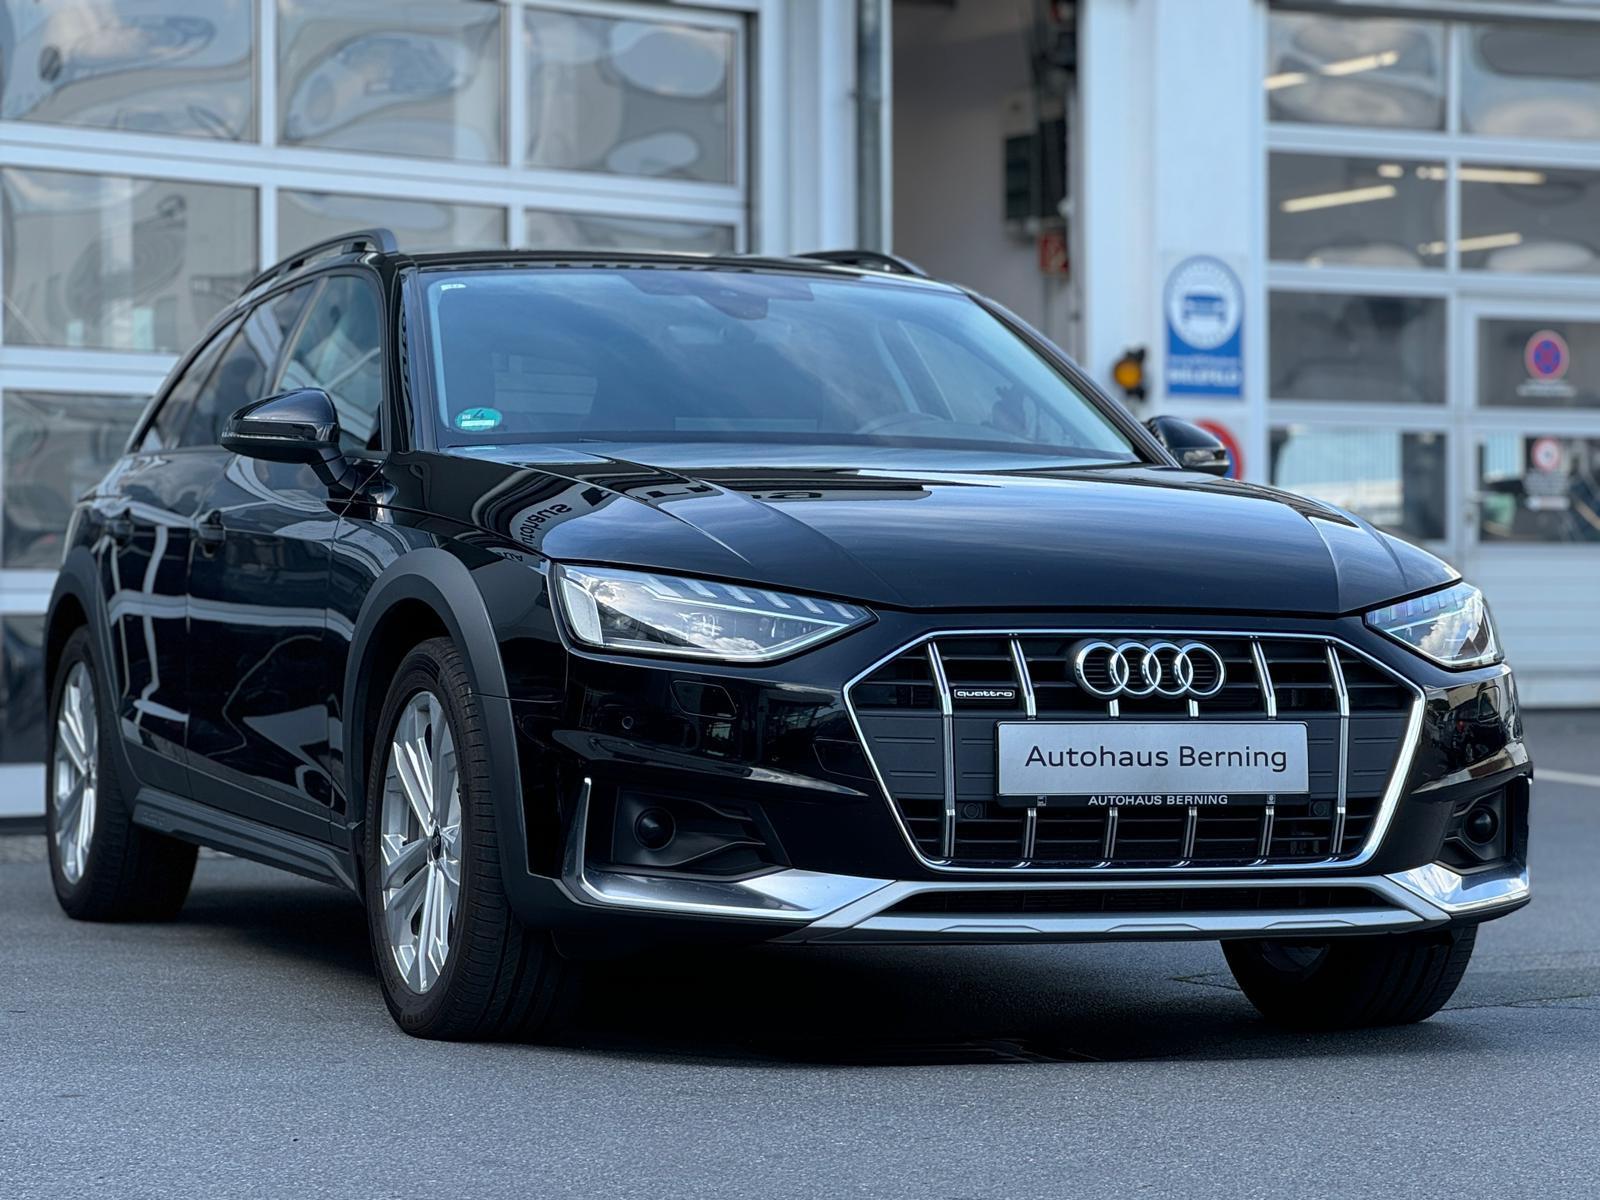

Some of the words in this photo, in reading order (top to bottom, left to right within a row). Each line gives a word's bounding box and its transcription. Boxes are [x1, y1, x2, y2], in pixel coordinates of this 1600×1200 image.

[956, 690, 1013, 698] quattro
[1025, 746, 1169, 767] Autohaus
[1179, 746, 1287, 772] Berning
[1088, 795, 1161, 806] AUTOHAUS
[1166, 795, 1228, 805] BERNING
